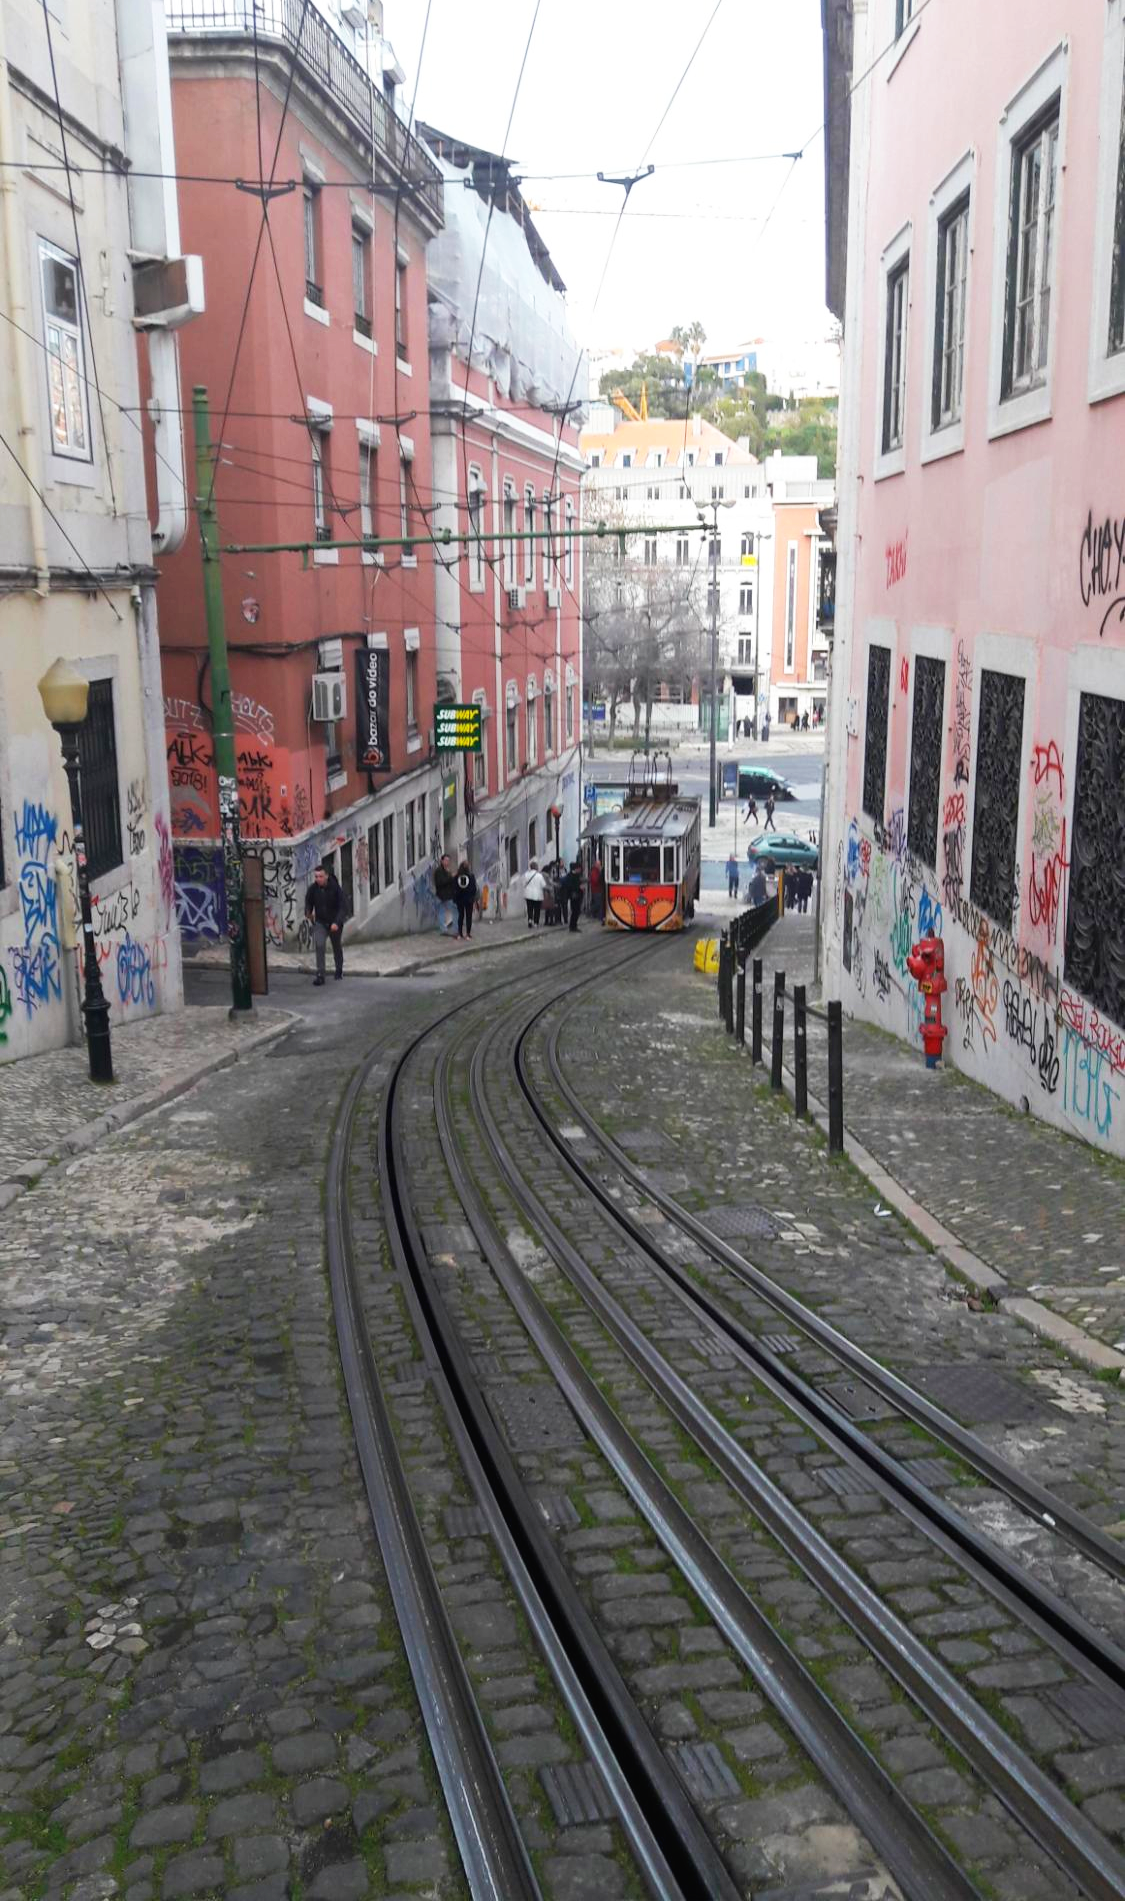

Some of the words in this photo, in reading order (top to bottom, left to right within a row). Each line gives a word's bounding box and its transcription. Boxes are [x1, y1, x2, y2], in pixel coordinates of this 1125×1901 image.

[366, 652, 378, 689] vídeo
[368, 690, 377, 708] do
[436, 709, 479, 720] SUBWAY
[368, 710, 378, 746] bazar
[436, 722, 479, 734] SUBWAY
[436, 736, 479, 747] SUBWAY
